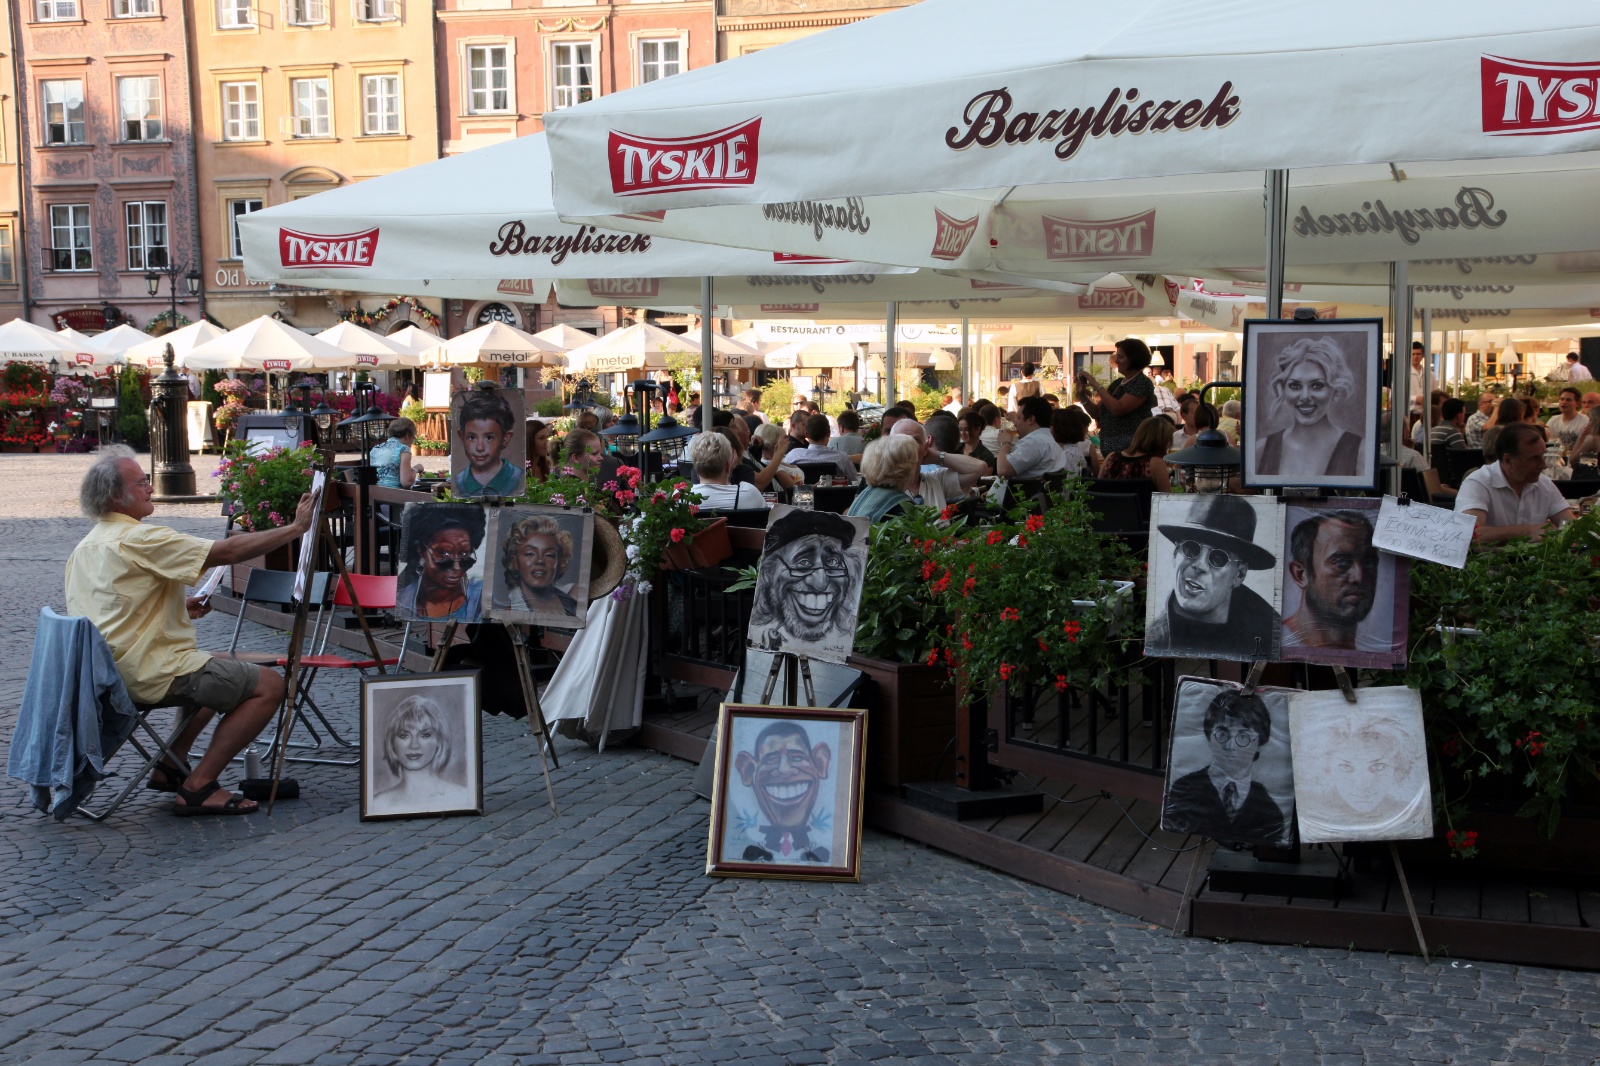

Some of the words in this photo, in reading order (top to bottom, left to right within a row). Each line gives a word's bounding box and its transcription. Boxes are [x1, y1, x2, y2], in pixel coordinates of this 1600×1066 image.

[1495, 71, 1600, 124] TYS
[945, 80, 1241, 161] Bazyliszek
[616, 133, 750, 187] TYSKIE
[285, 235, 372, 263] TYSKIE
[215, 269, 239, 287] Old
[770, 325, 832, 335] RESTAURANT
